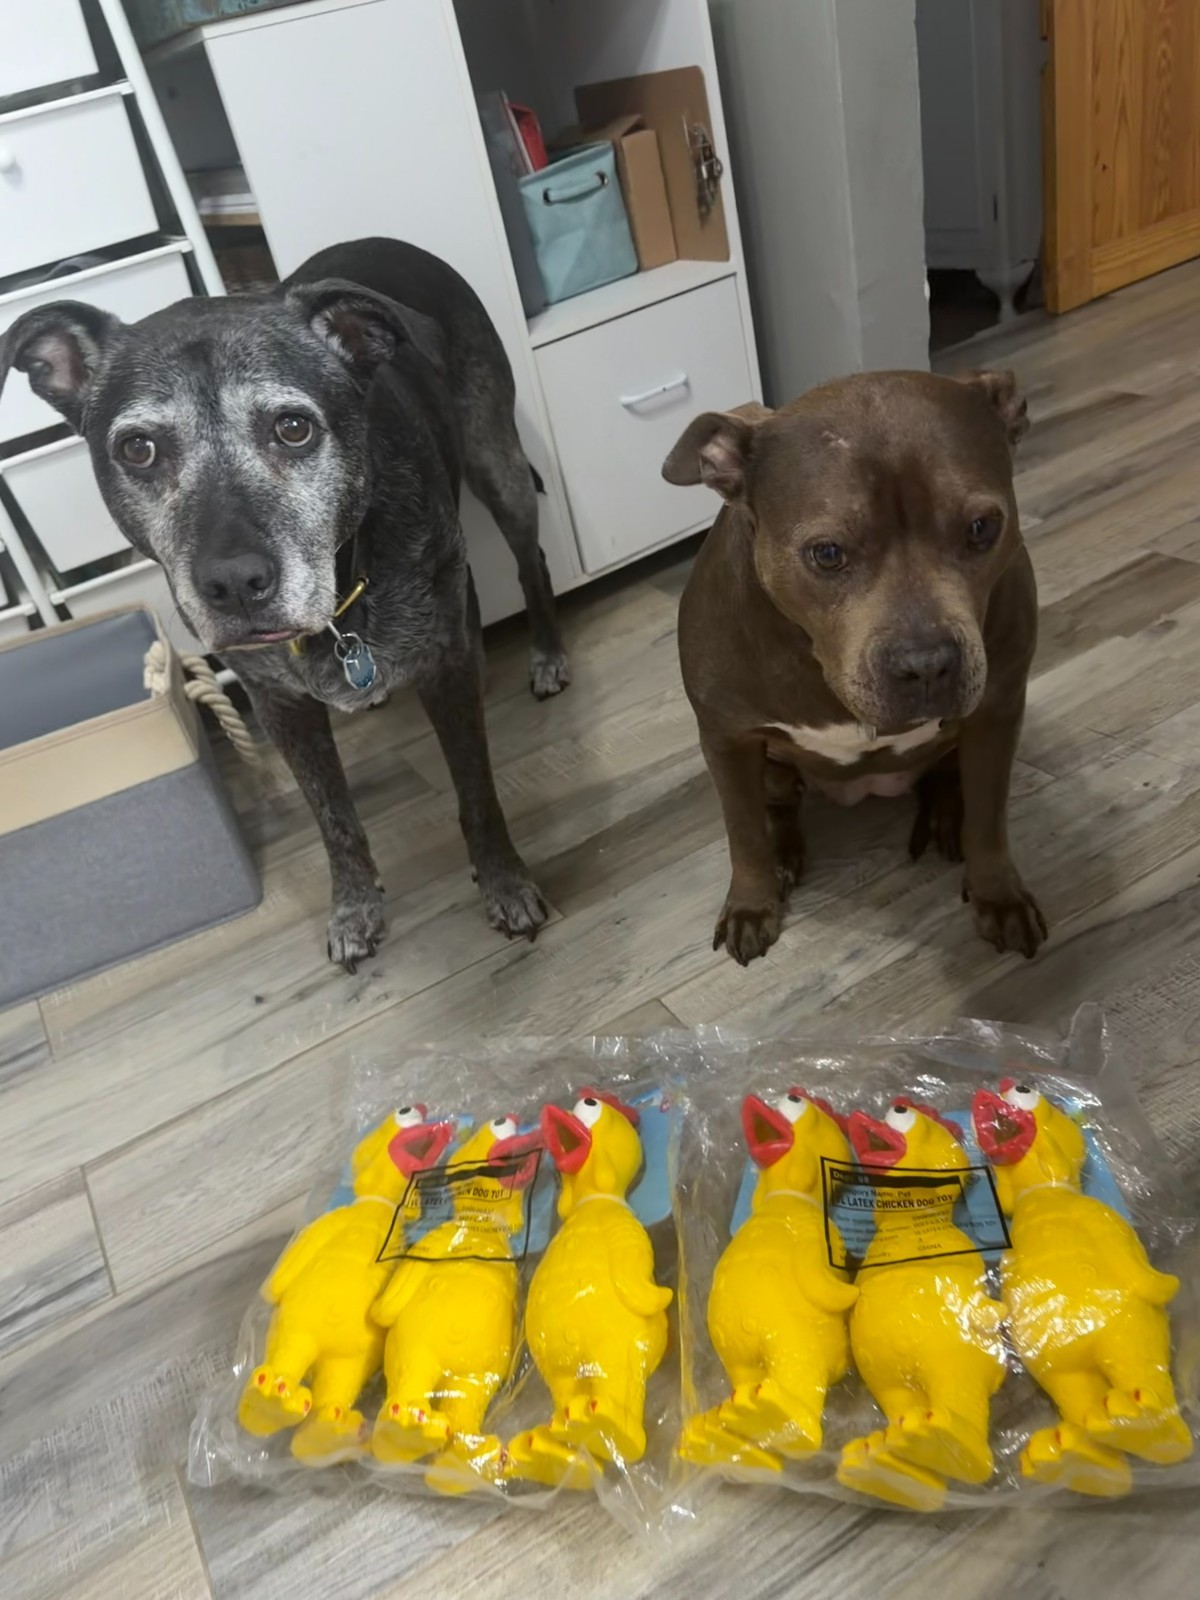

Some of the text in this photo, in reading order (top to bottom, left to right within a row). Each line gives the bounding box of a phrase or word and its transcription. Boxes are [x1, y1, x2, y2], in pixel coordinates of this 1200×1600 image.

[473, 1188, 489, 1198] DOG
[847, 1196, 875, 1209] LATEX
[876, 1199, 915, 1209] CHICKEN
[916, 1198, 935, 1207] DOG
[936, 1194, 953, 1203] TOY
